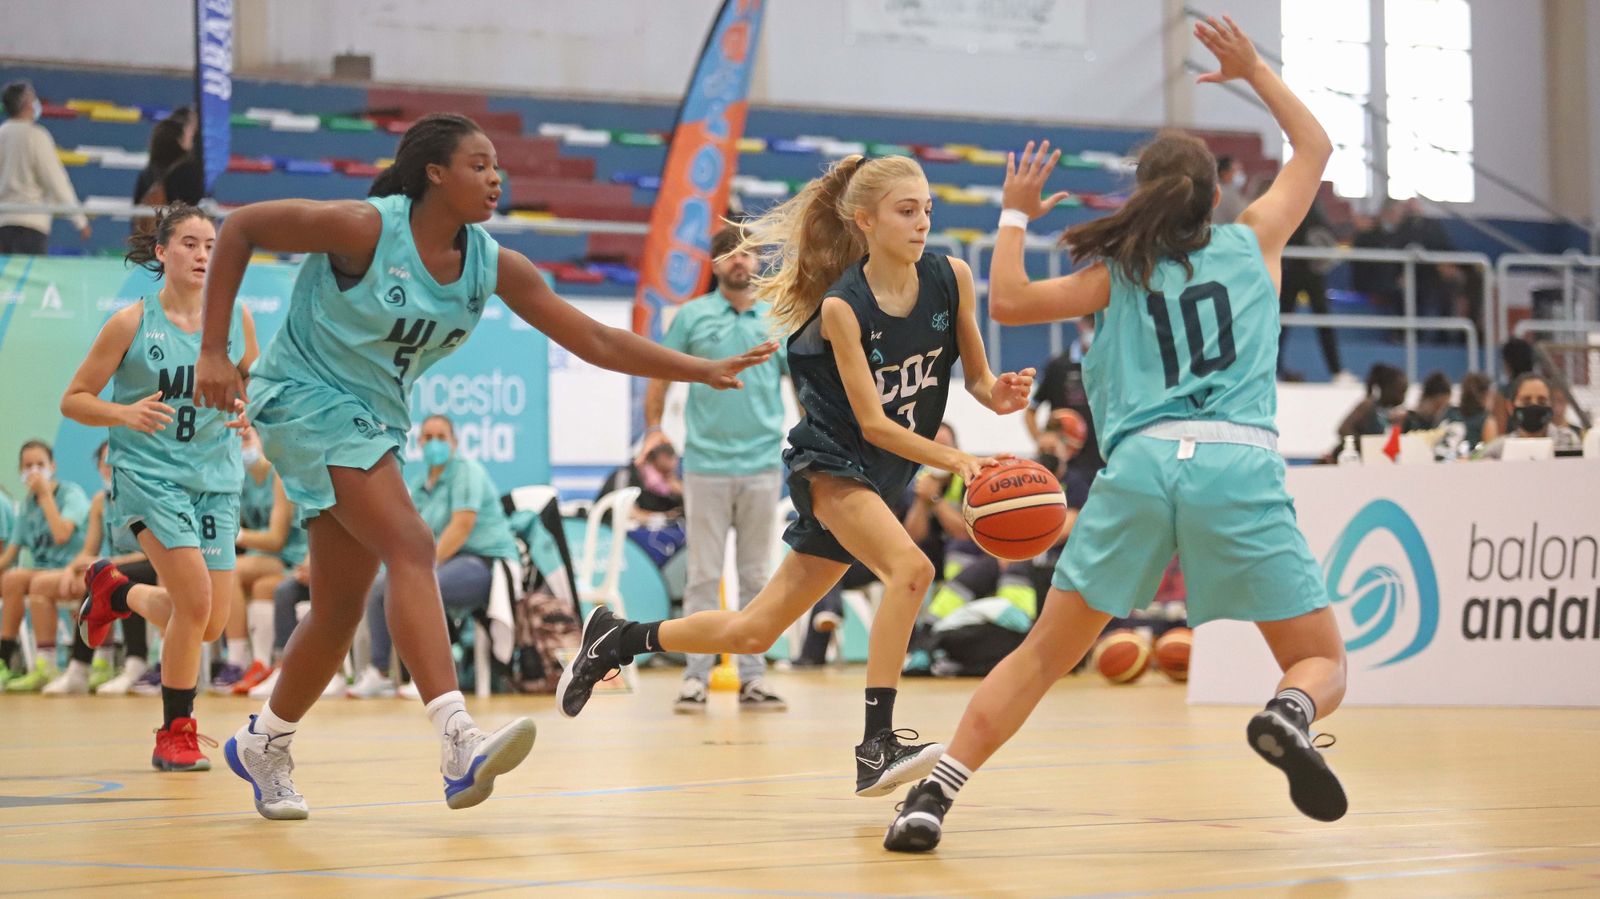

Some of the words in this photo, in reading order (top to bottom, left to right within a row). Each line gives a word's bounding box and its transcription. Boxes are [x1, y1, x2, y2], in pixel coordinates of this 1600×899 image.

[1146, 280, 1237, 389] 10
[175, 405, 197, 442] 8
[990, 474, 1048, 493] molten
[201, 514, 217, 540] 8
[1467, 521, 1599, 581] balon
